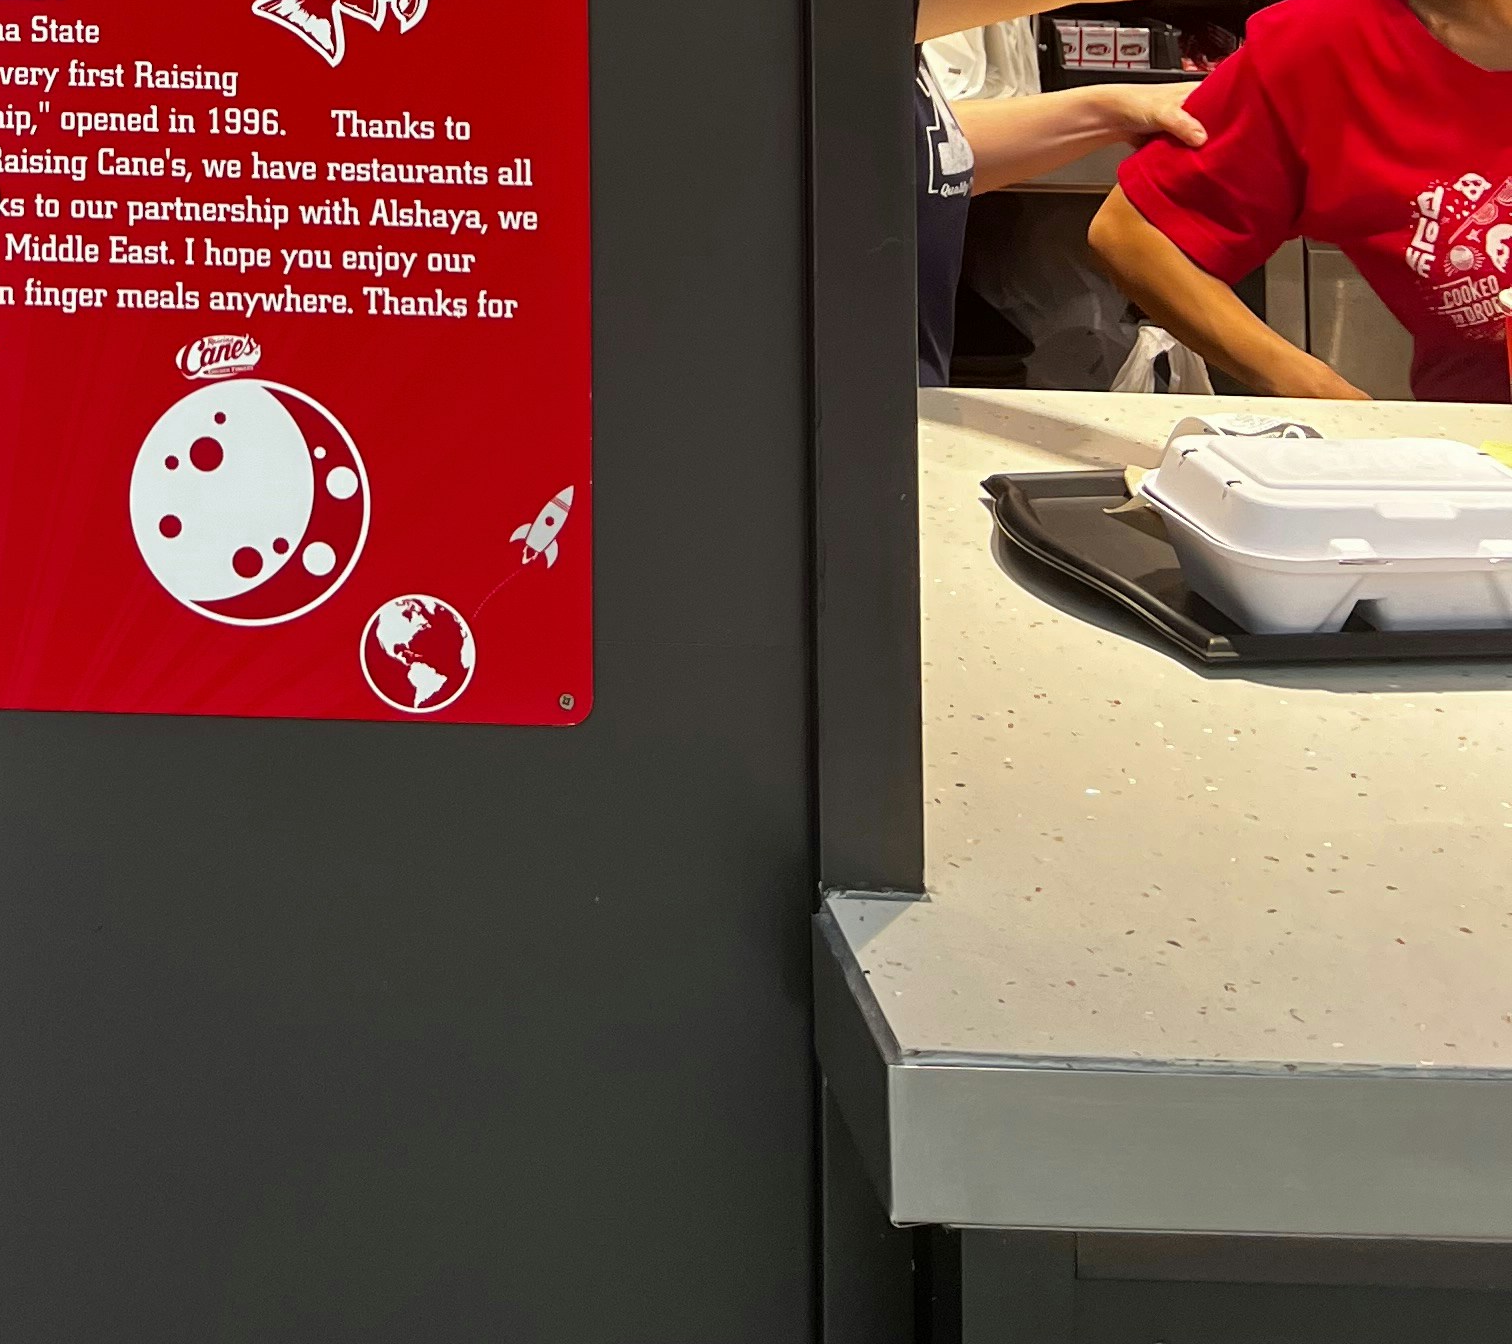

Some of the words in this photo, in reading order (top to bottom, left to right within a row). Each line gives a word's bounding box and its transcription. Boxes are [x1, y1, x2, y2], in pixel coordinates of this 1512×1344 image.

[31, 15, 100, 44] State
[67, 58, 125, 88] first
[133, 60, 239, 98] Raising
[97, 147, 193, 183] Cane's,
[201, 158, 242, 179] we
[251, 151, 317, 181] have
[326, 158, 489, 185] restaurants
[497, 157, 533, 187] all
